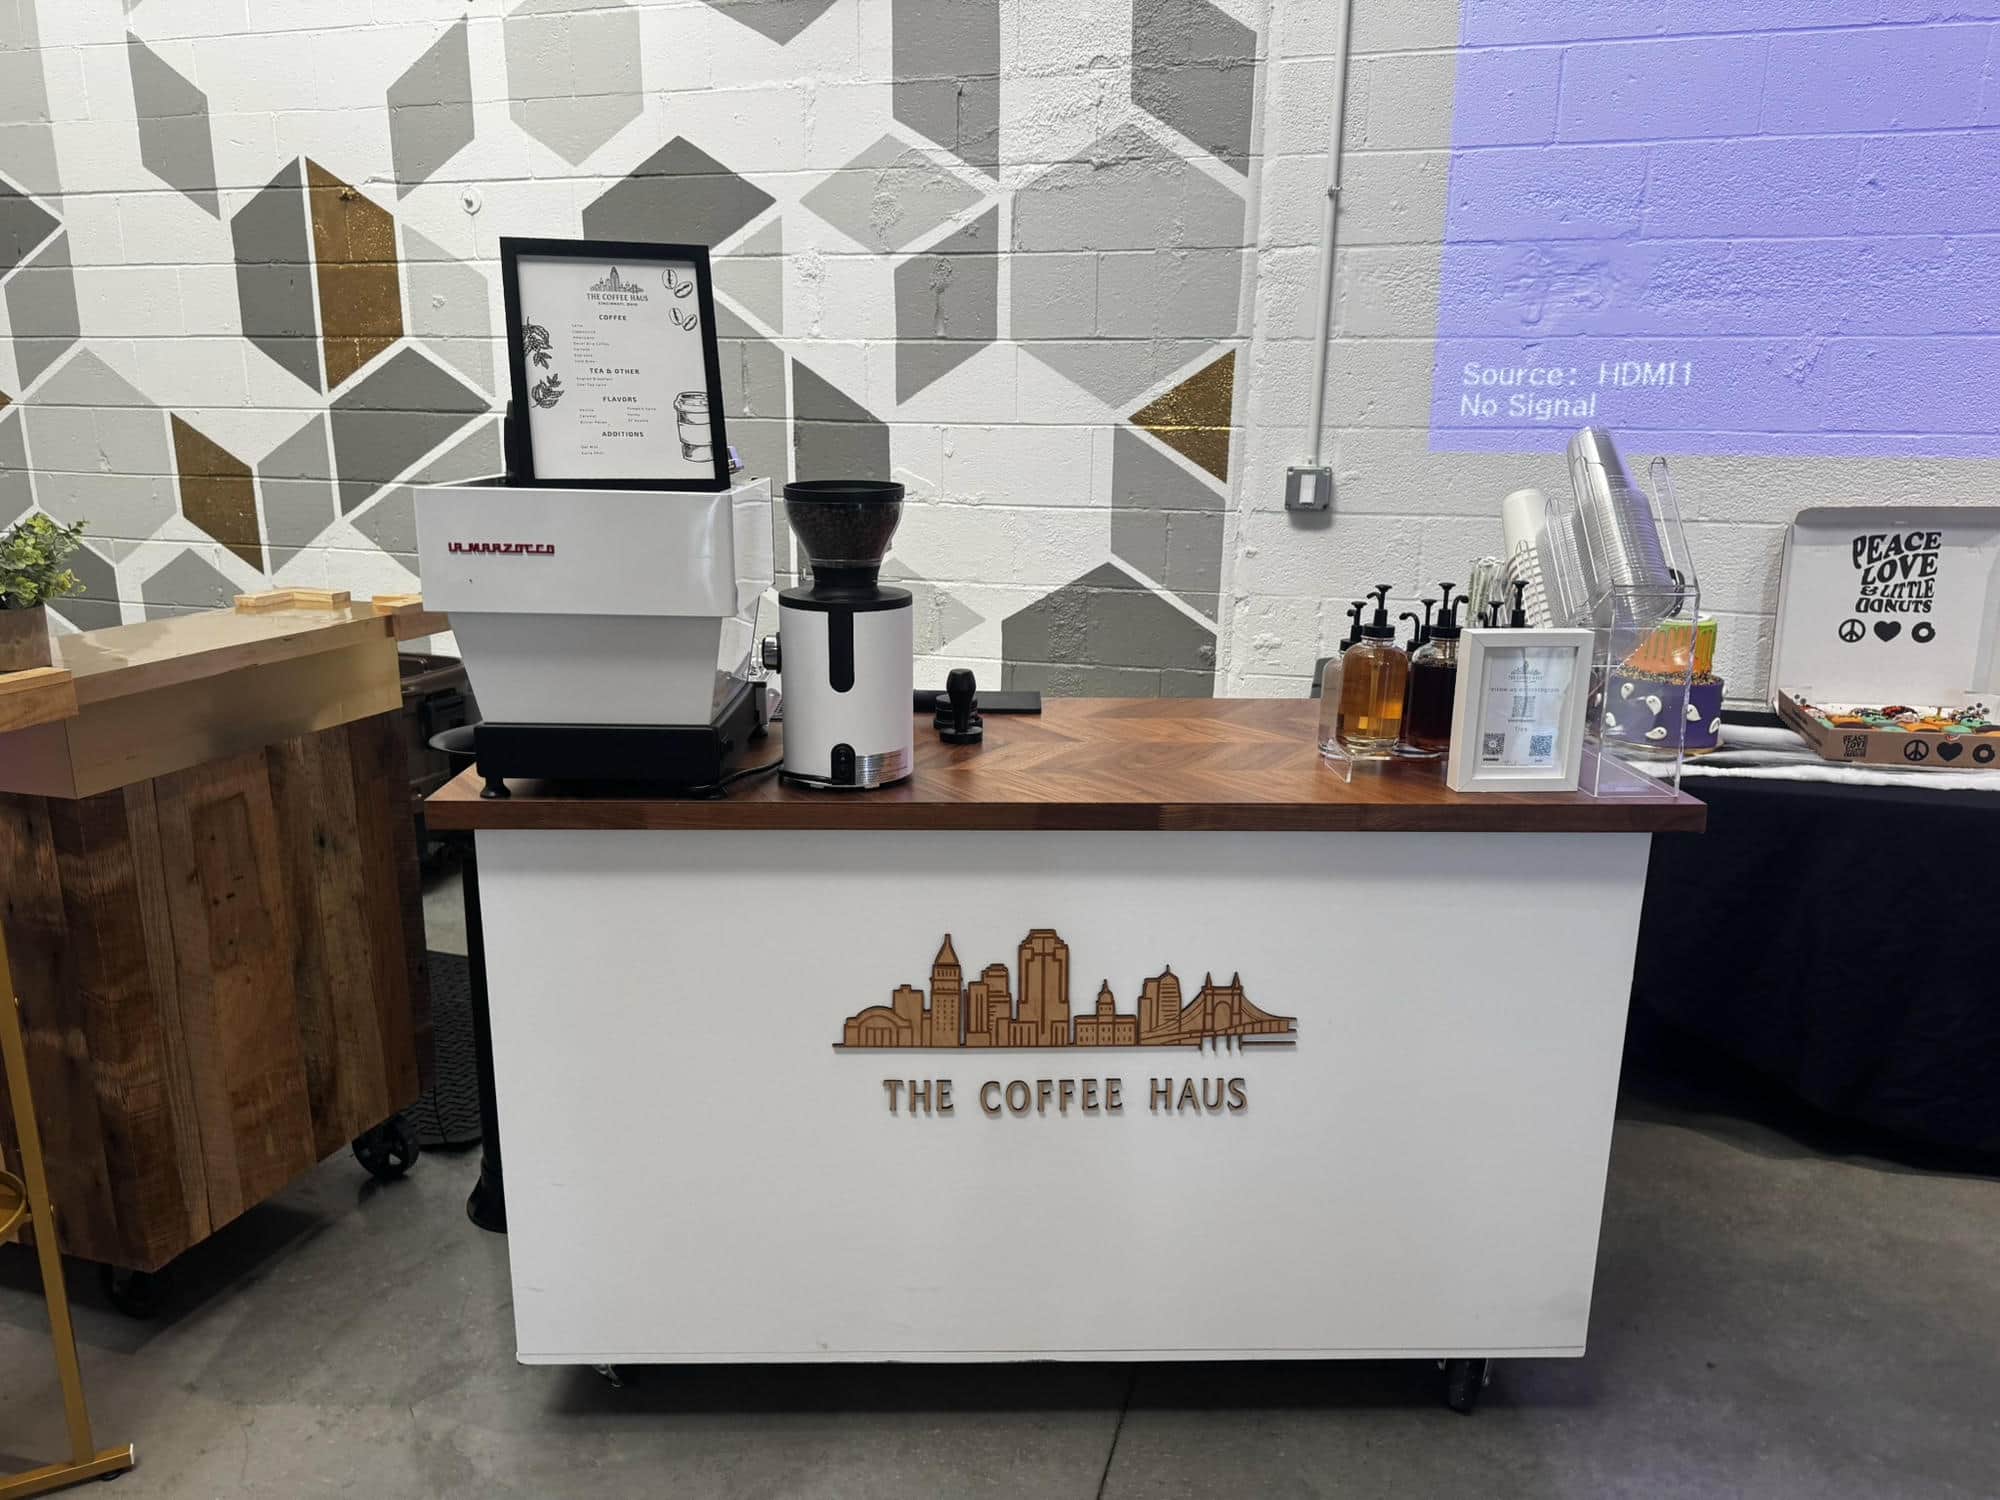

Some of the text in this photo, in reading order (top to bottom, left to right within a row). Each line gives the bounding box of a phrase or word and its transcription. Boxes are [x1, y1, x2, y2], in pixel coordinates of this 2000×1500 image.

[587, 293, 600, 301] THE
[589, 367, 604, 375] TEA
[1462, 360, 1693, 387] Source: HDMI1
[1460, 392, 1598, 421] No Signal
[1852, 531, 1942, 569] PEACE
[1861, 552, 1939, 586] LOVE
[1860, 577, 1936, 599] & LITTLE
[1855, 597, 1934, 614] DONUTS
[883, 1077, 1249, 1115] THE COFFEE HAUS
